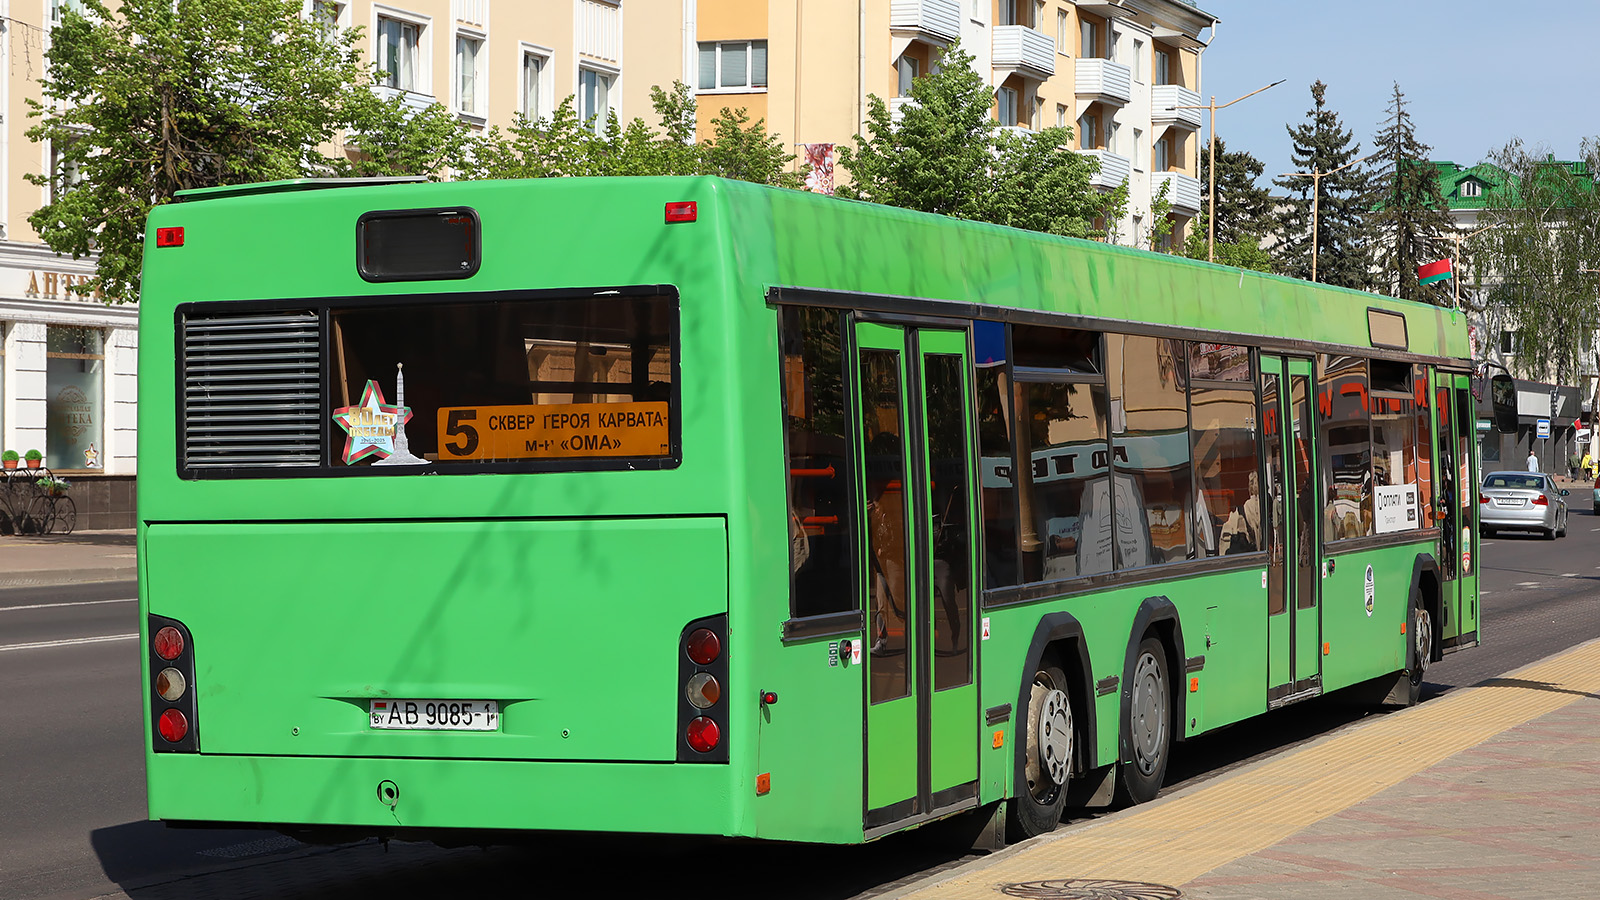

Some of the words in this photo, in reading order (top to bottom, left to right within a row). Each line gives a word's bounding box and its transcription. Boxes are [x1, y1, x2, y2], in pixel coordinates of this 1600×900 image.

[25, 270, 121, 300] АПТЕ
[52, 413, 93, 424] ПТЕКА
[349, 407, 373, 426] 80
[374, 414, 395, 425] ЛЕТ
[349, 426, 395, 437] ПОБЕДЫ
[445, 409, 479, 457] 5
[488, 415, 535, 430] СКВЕР
[543, 413, 590, 429] ГЕРОЯ
[560, 434, 621, 450] «ОМА»
[373, 715, 385, 724] BY
[388, 701, 419, 725] AB
